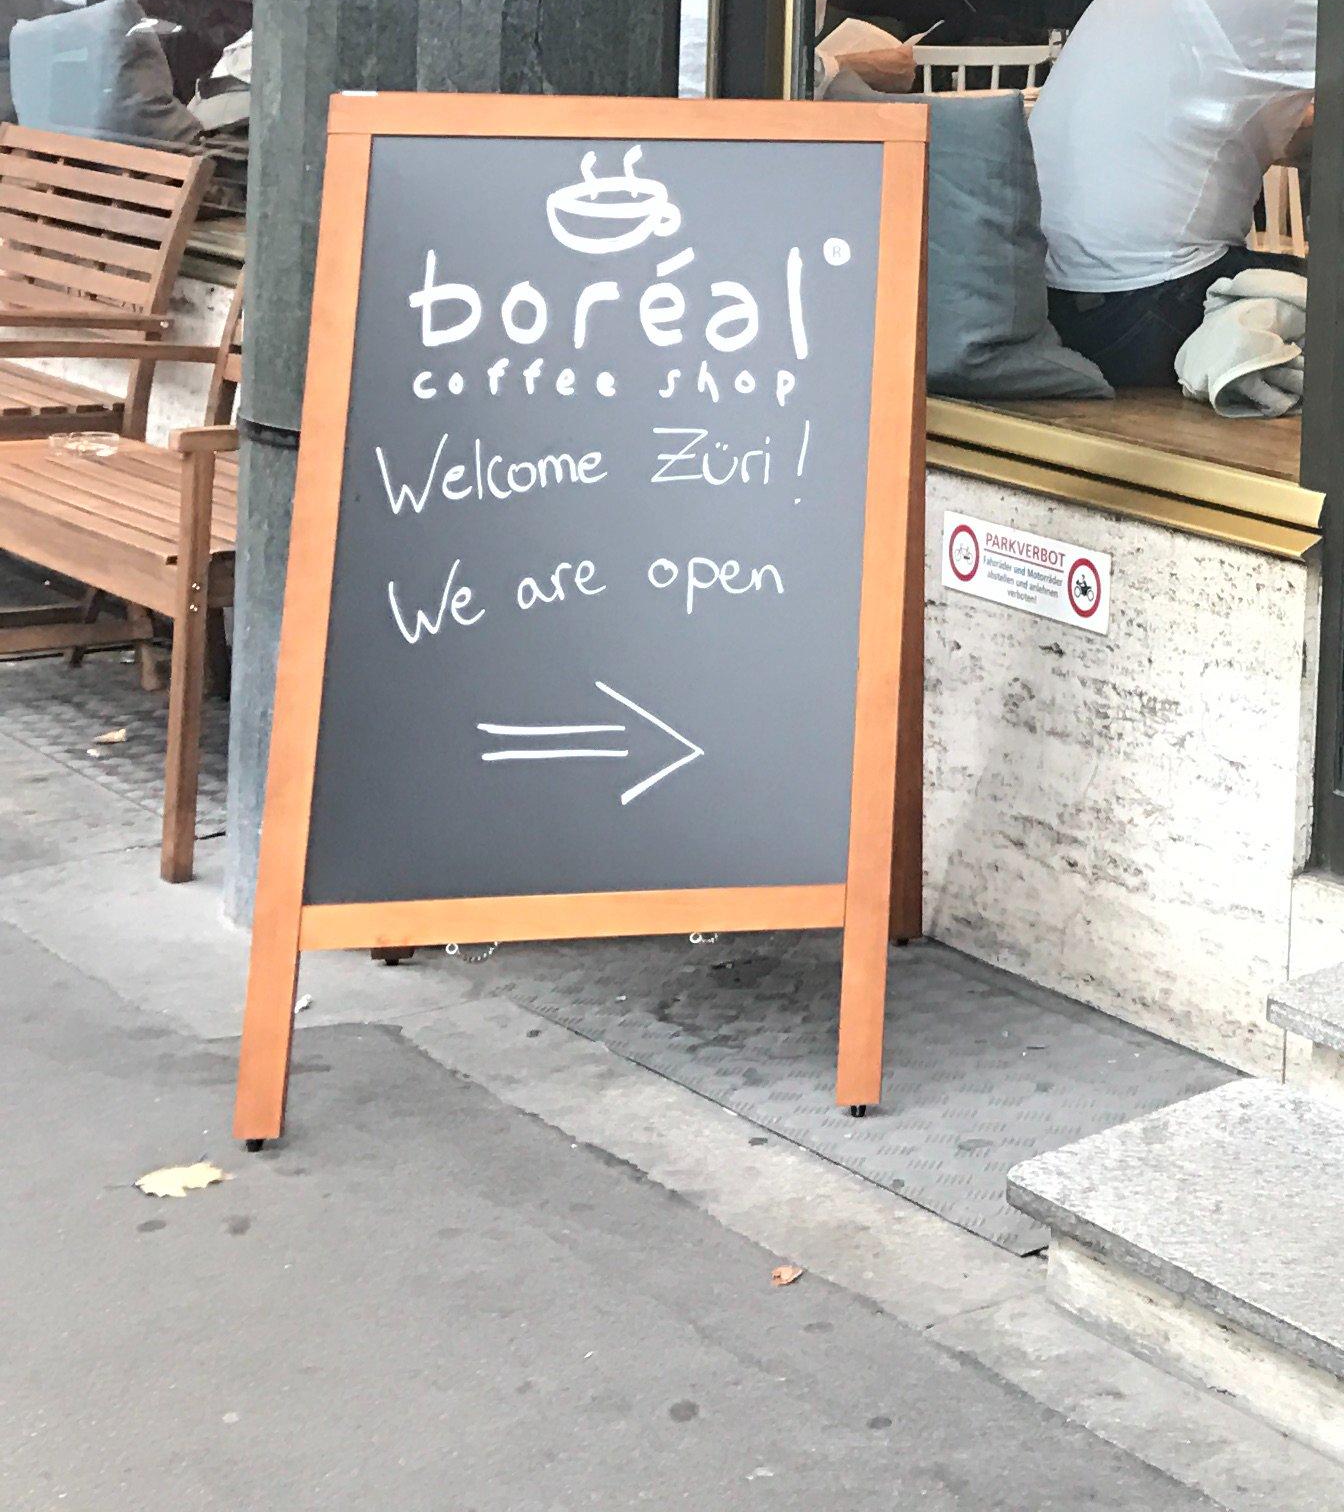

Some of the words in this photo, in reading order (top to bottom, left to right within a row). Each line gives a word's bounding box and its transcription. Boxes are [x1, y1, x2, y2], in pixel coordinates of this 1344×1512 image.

[409, 246, 809, 360] boréal
[412, 359, 617, 401] coffee
[658, 361, 799, 407] shop
[375, 433, 609, 516] Welcome
[985, 532, 1066, 567] PARKVERBOT
[388, 559, 486, 644] We
[517, 561, 607, 610] are
[647, 556, 786, 614] open
